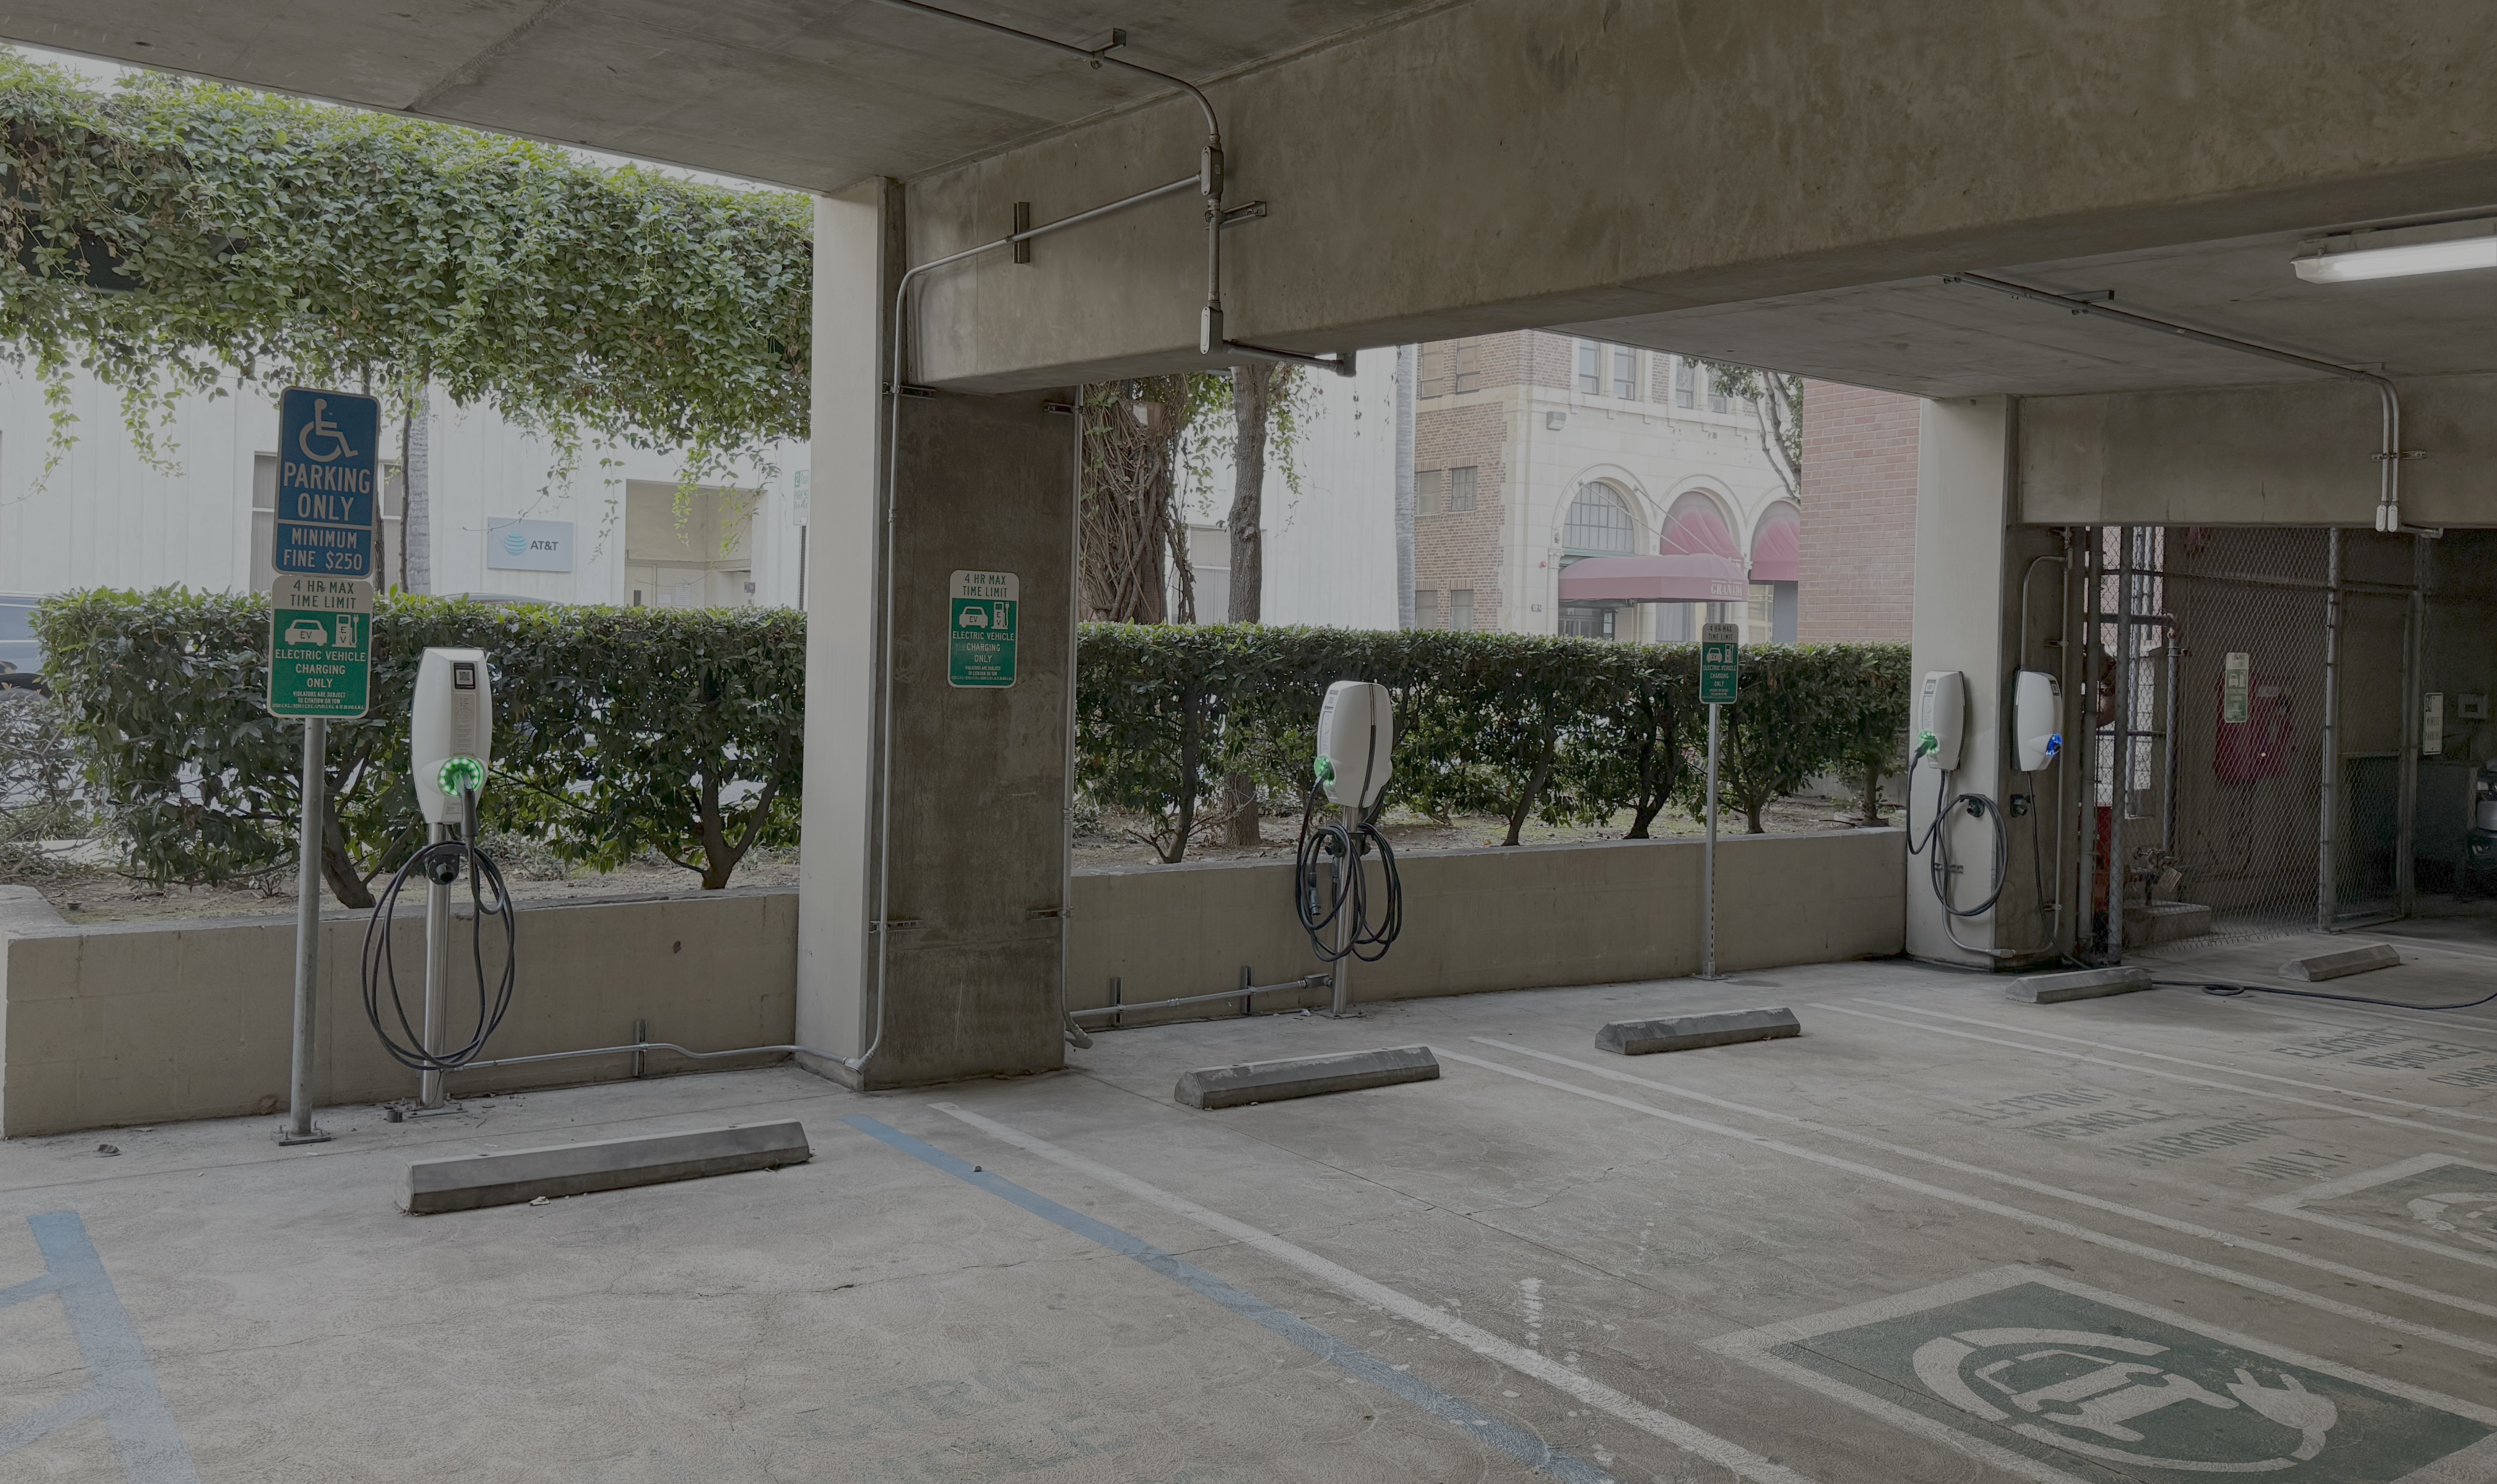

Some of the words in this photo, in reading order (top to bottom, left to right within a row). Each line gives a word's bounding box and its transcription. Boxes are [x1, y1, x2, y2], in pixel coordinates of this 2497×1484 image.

[284, 462, 370, 494] PARKING
[796, 473, 800, 485] 2
[298, 493, 354, 521] ONLY
[291, 528, 357, 549] MINIMUM
[530, 540, 559, 551] AT&T
[284, 549, 316, 567] FINE
[325, 551, 363, 570] $250
[965, 574, 970, 583] 4
[974, 574, 985, 584] HR
[989, 575, 1006, 585] MAX
[294, 580, 301, 591] 4
[308, 581, 325, 592] HR
[330, 582, 354, 594] MAX
[963, 586, 982, 596] TIME
[986, 587, 1007, 598] LIMIT
[1711, 584, 1742, 596] GRANADA
[291, 595, 318, 607] TIME
[325, 596, 356, 609] LIMIT
[952, 631, 984, 639] ELECTRIC
[987, 632, 1014, 641] VEHICLE
[966, 643, 1000, 652] CHARGING
[275, 649, 322, 660] ELECTRIC
[326, 651, 366, 662] VEHICLE
[295, 664, 346, 674] CHARGING
[307, 678, 333, 688] ONLY
[2271, 1033, 2405, 1058] ELECTRIC
[2347, 1044, 2480, 1070] VEHICLE
